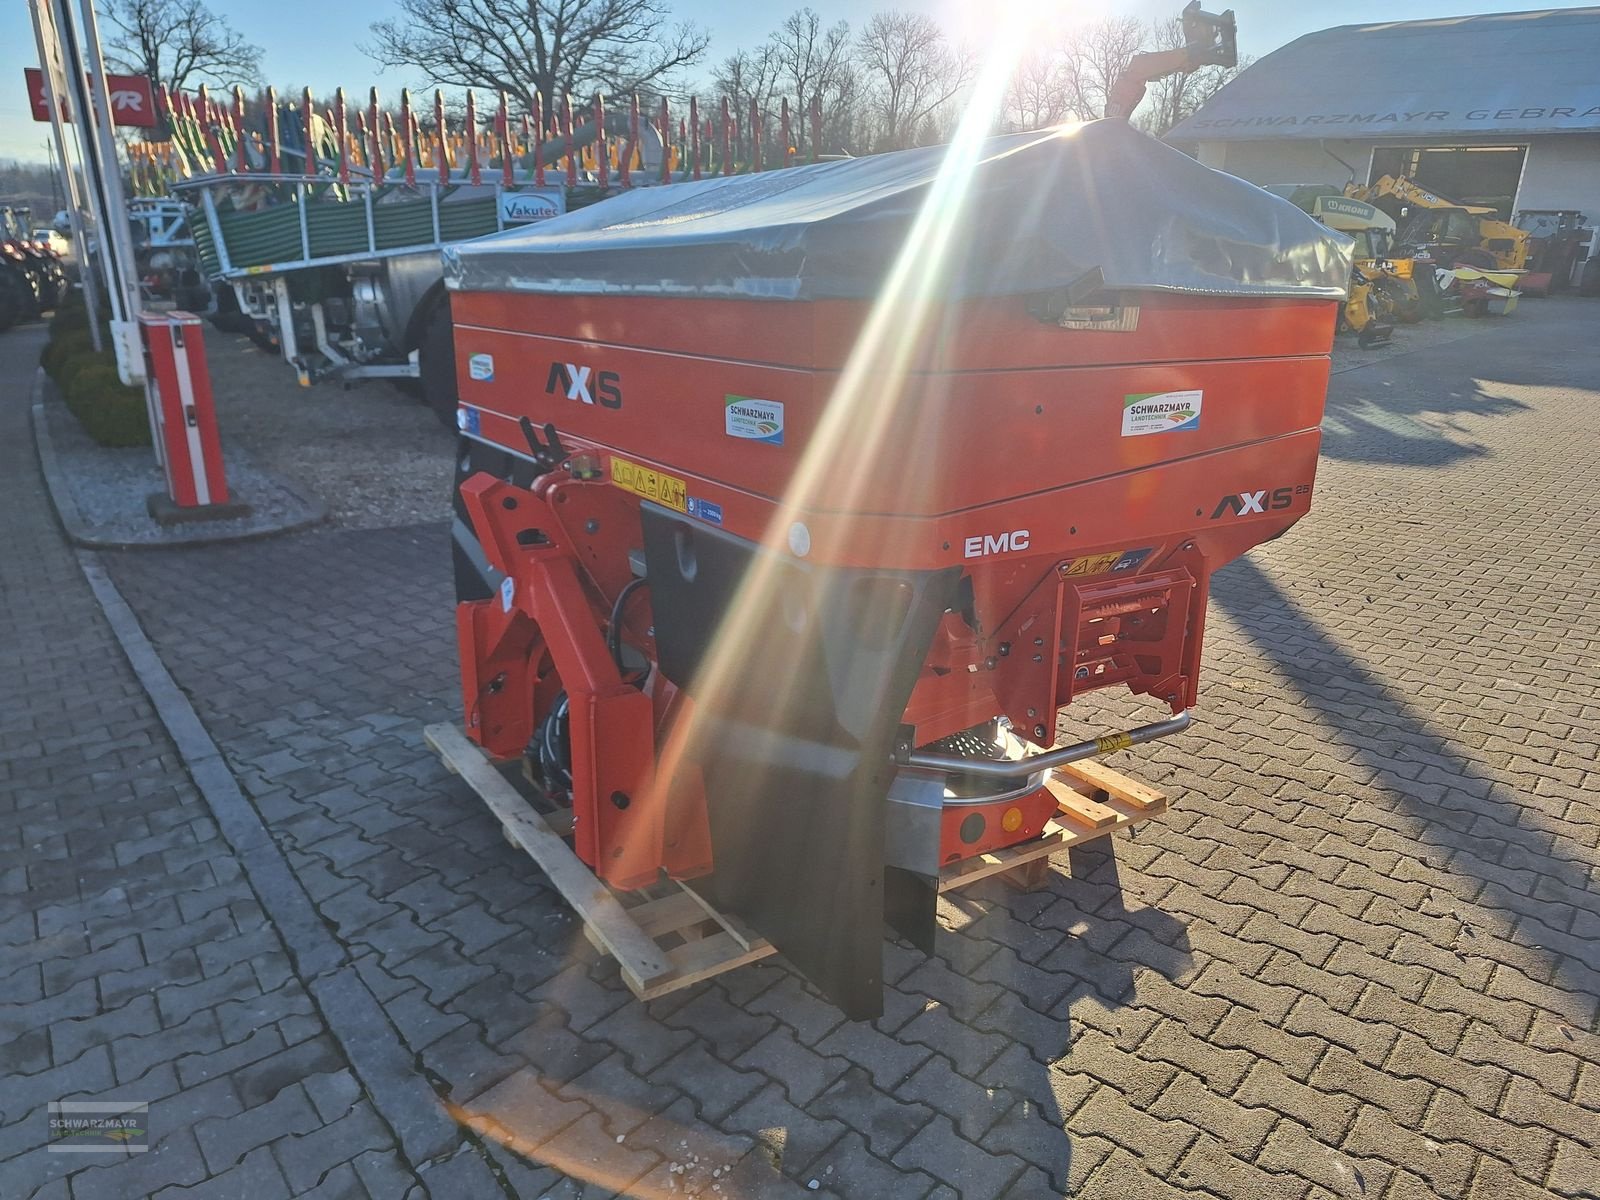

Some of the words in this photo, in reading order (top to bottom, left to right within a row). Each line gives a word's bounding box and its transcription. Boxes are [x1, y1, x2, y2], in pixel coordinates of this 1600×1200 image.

[1193, 111, 1450, 129] SCHWARZMAYR
[505, 202, 559, 218] Vakutec
[1338, 203, 1369, 216] KRONE
[545, 362, 622, 409] AXIS
[730, 405, 775, 421] SCHWARZMAYR
[1130, 402, 1191, 415] SCHWARZMAYR
[1131, 413, 1167, 422] LANDTECHNIK
[1210, 488, 1293, 520] AXIS
[1295, 485, 1310, 495] 25
[964, 529, 1030, 558] EMC
